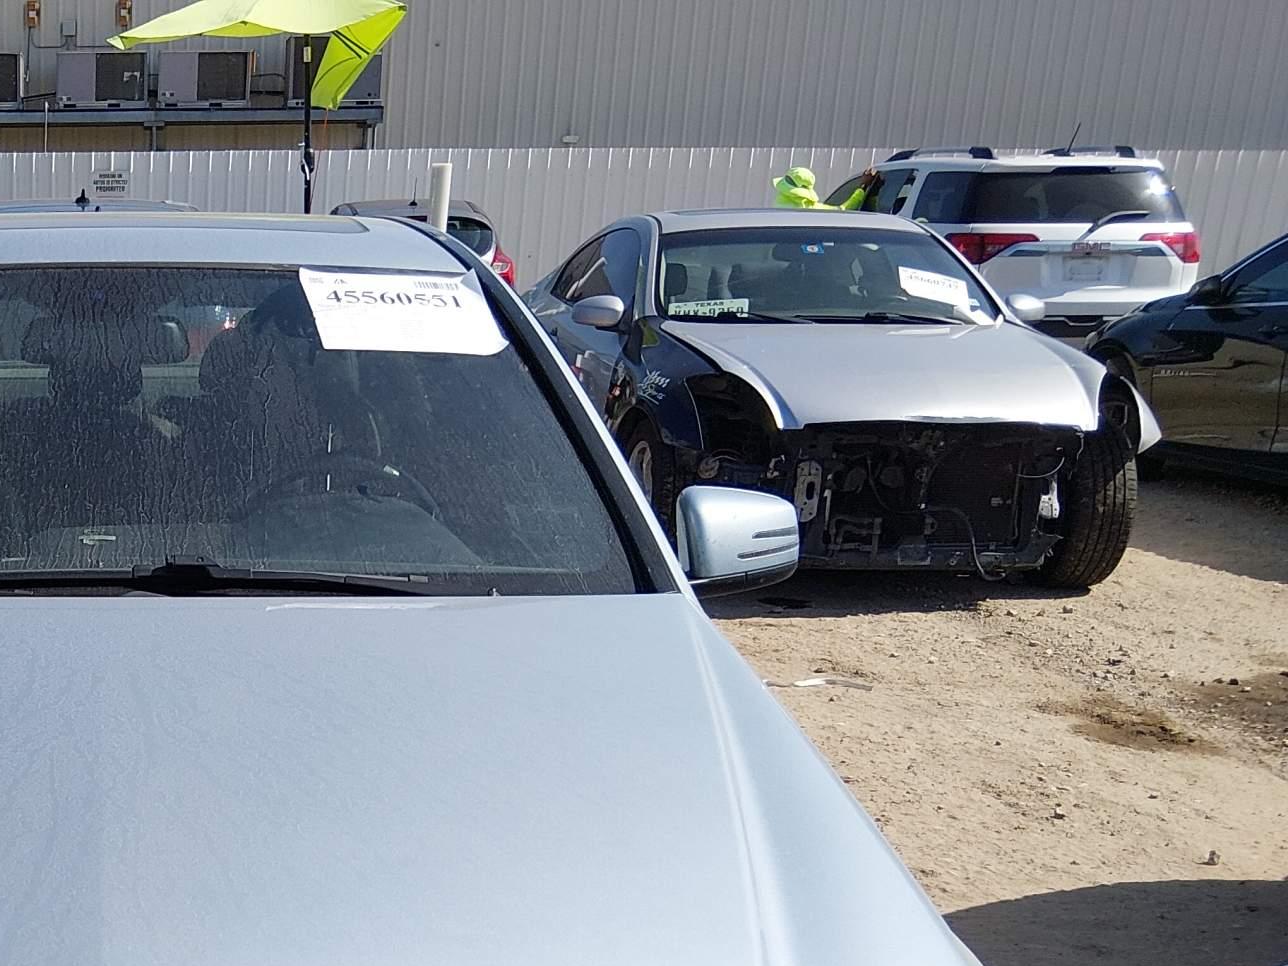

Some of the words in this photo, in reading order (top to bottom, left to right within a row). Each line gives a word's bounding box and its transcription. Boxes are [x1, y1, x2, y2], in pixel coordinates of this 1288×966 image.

[1072, 242, 1111, 251] GMC
[326, 289, 462, 308] 45560551
[695, 301, 725, 309] TEXAS
